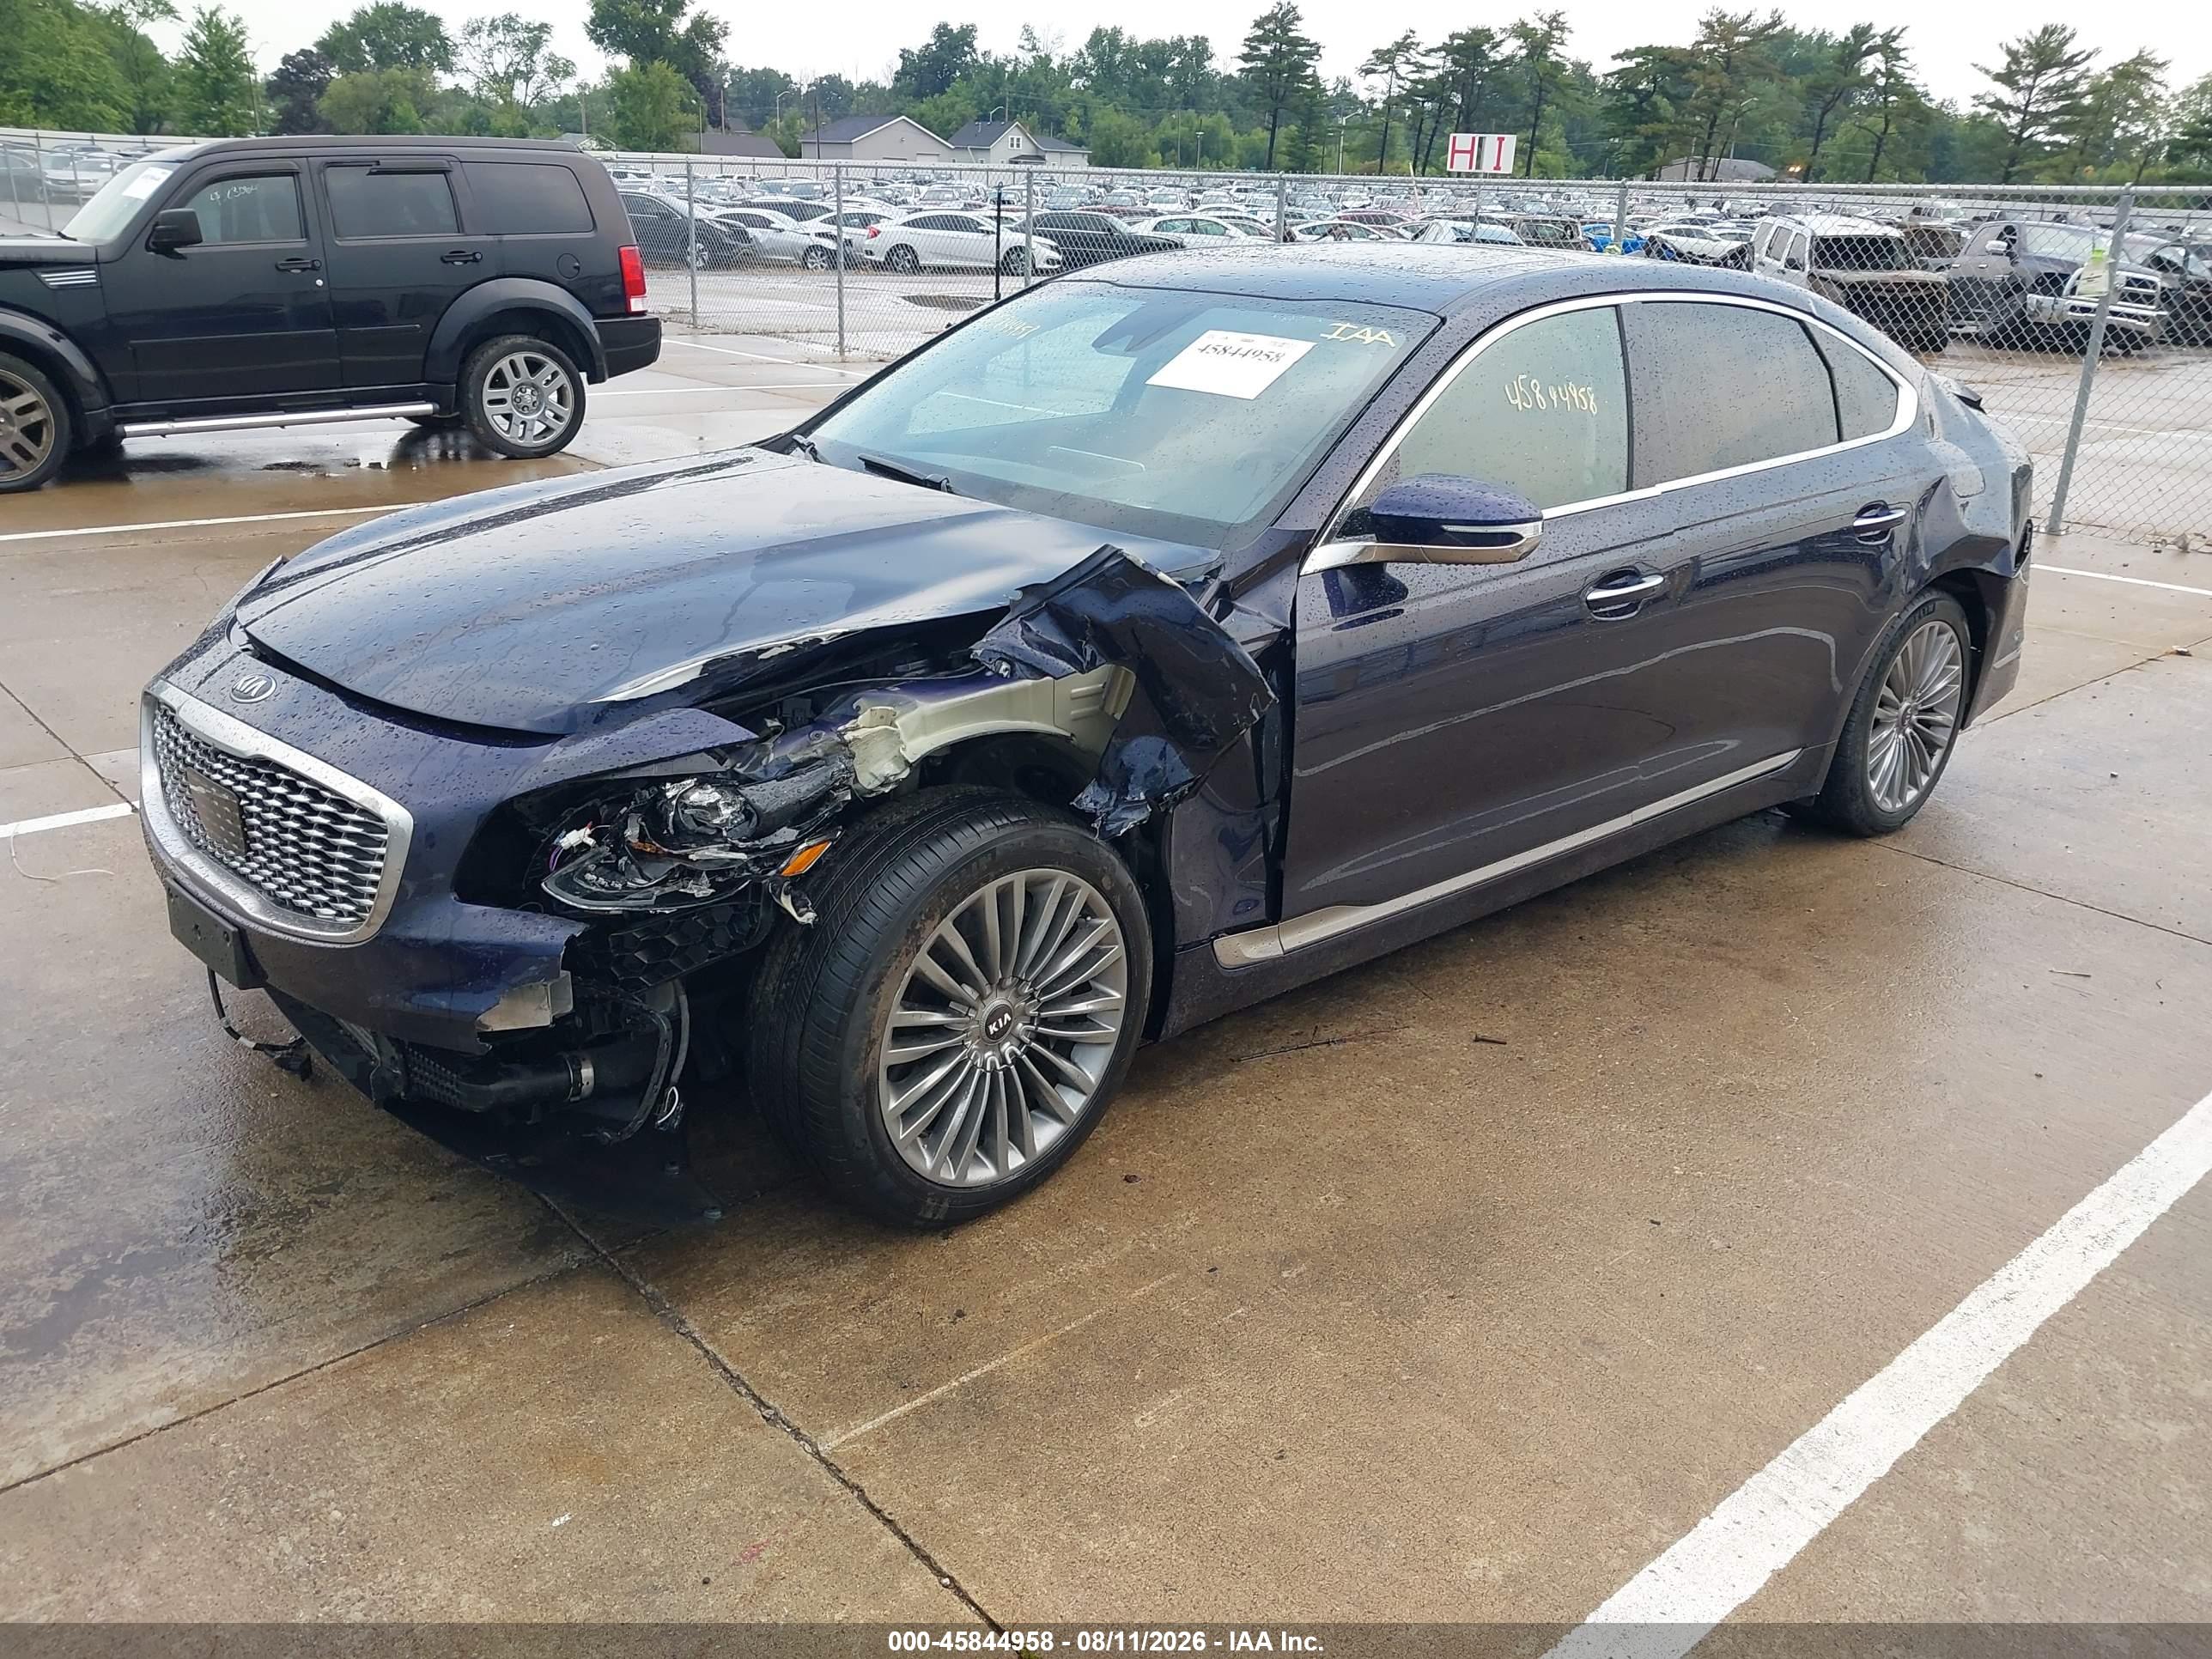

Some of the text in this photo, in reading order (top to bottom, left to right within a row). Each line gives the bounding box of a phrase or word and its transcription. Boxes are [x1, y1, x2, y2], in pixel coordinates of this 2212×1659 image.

[1320, 323, 1395, 348] IAA
[1198, 343, 1285, 362] 45844958
[988, 1012, 1012, 1036] KIA
